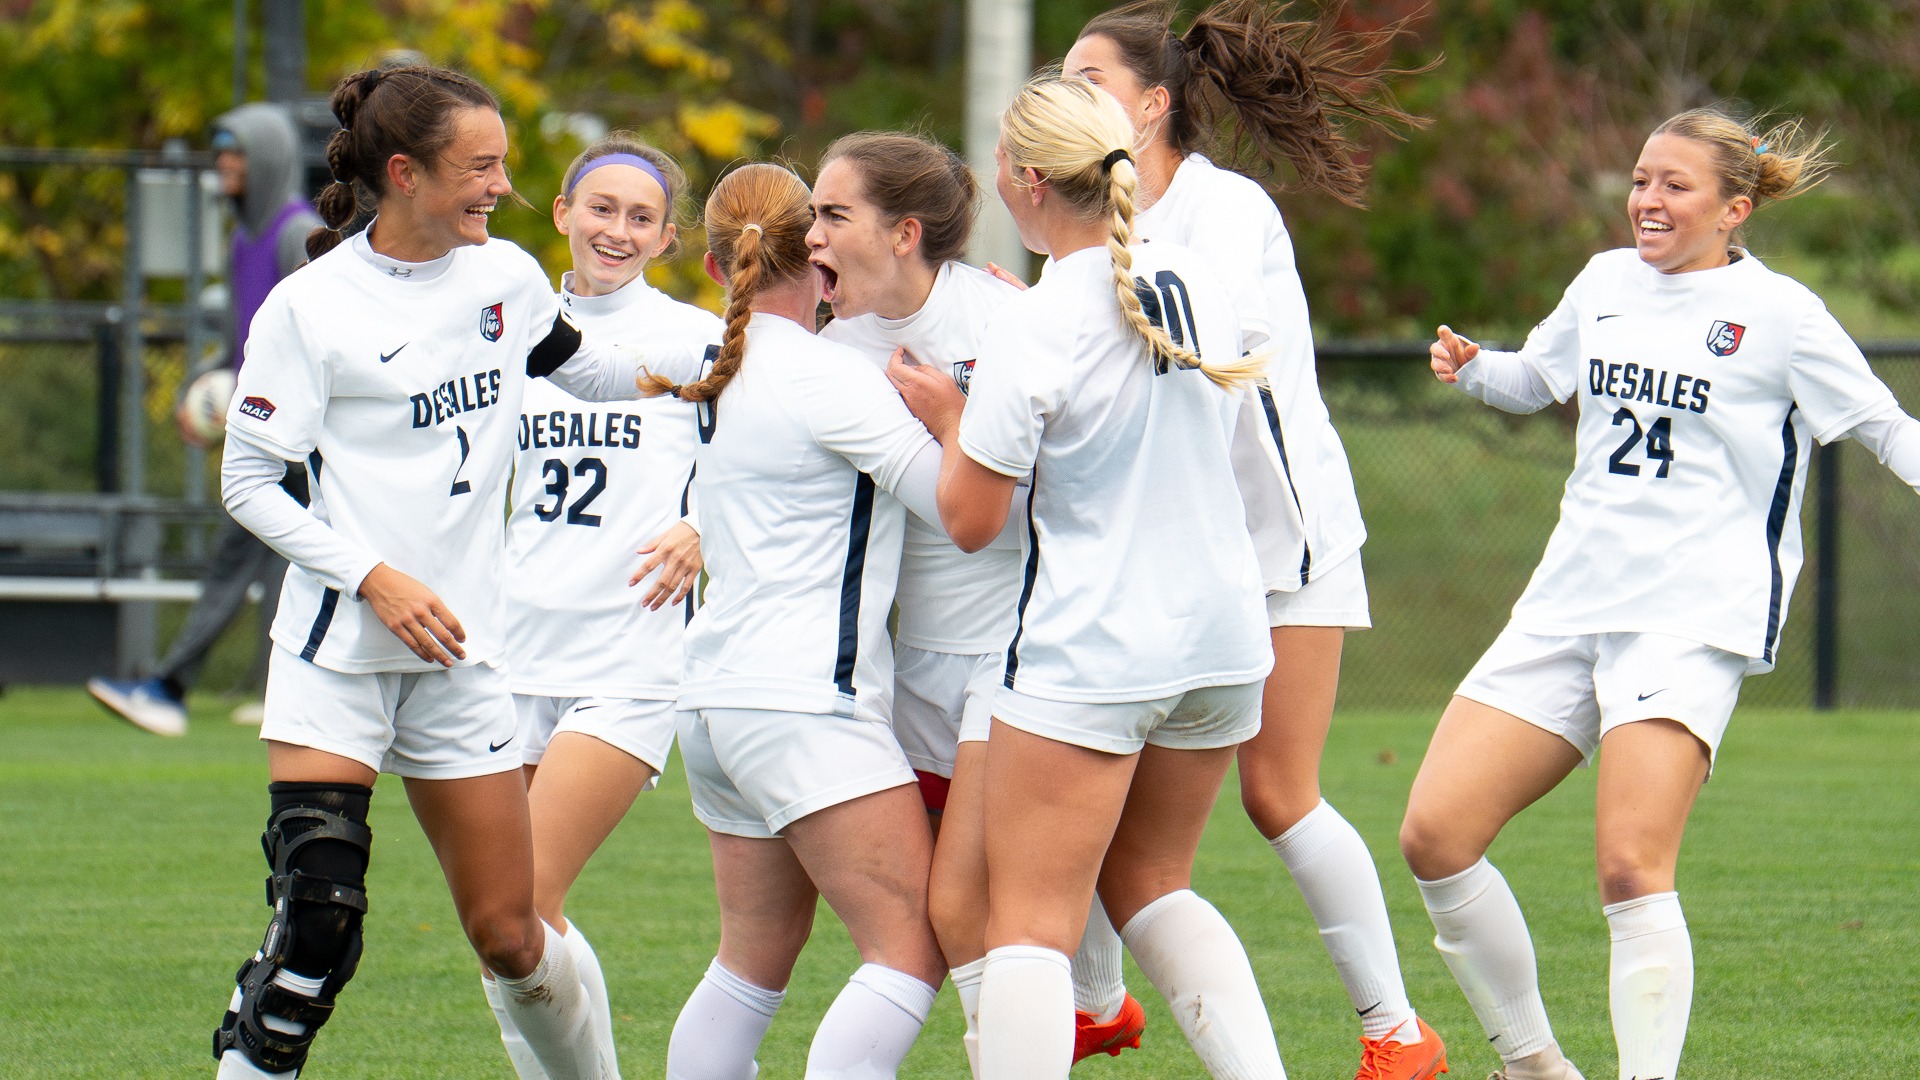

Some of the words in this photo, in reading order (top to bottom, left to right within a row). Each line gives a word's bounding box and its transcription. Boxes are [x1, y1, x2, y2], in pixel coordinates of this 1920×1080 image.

[240, 402, 270, 420] MAC
[409, 368, 501, 429] DESALES
[1589, 358, 1711, 414] DESALES
[449, 425, 472, 497] 2
[1608, 406, 1675, 479] 24
[534, 457, 608, 527] 32
